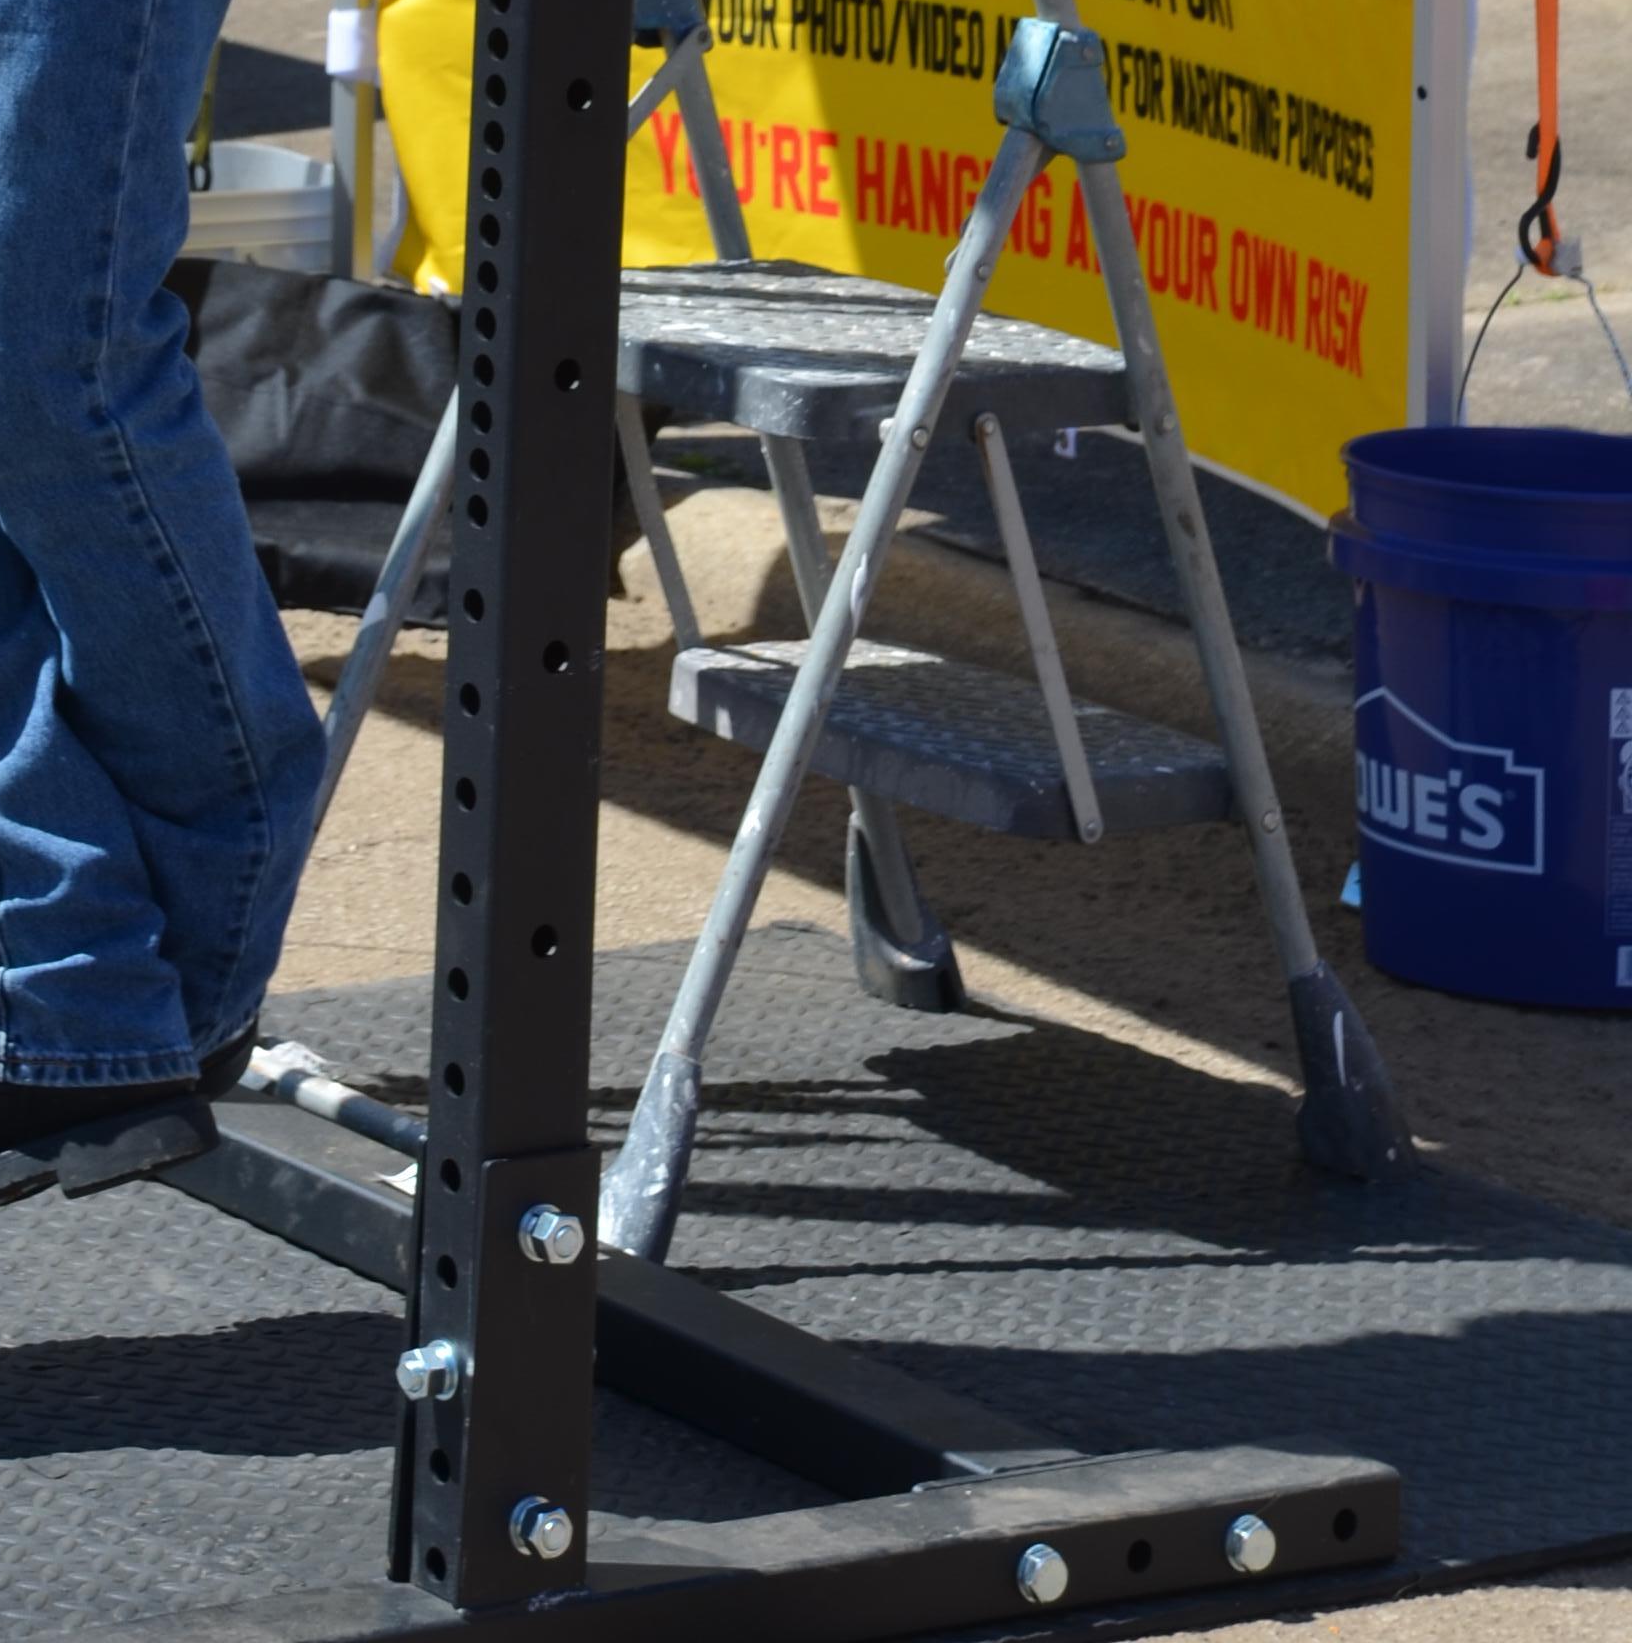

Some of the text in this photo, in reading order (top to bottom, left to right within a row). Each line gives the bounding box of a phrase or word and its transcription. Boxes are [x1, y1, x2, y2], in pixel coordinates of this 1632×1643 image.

[1116, 42, 1166, 125] FOR
[1169, 54, 1281, 163] MARKETING
[1286, 91, 1376, 202] PURPOSES
[854, 135, 1053, 260] HANGG
[1228, 227, 1298, 344] OWN
[1304, 258, 1369, 380] RISK
